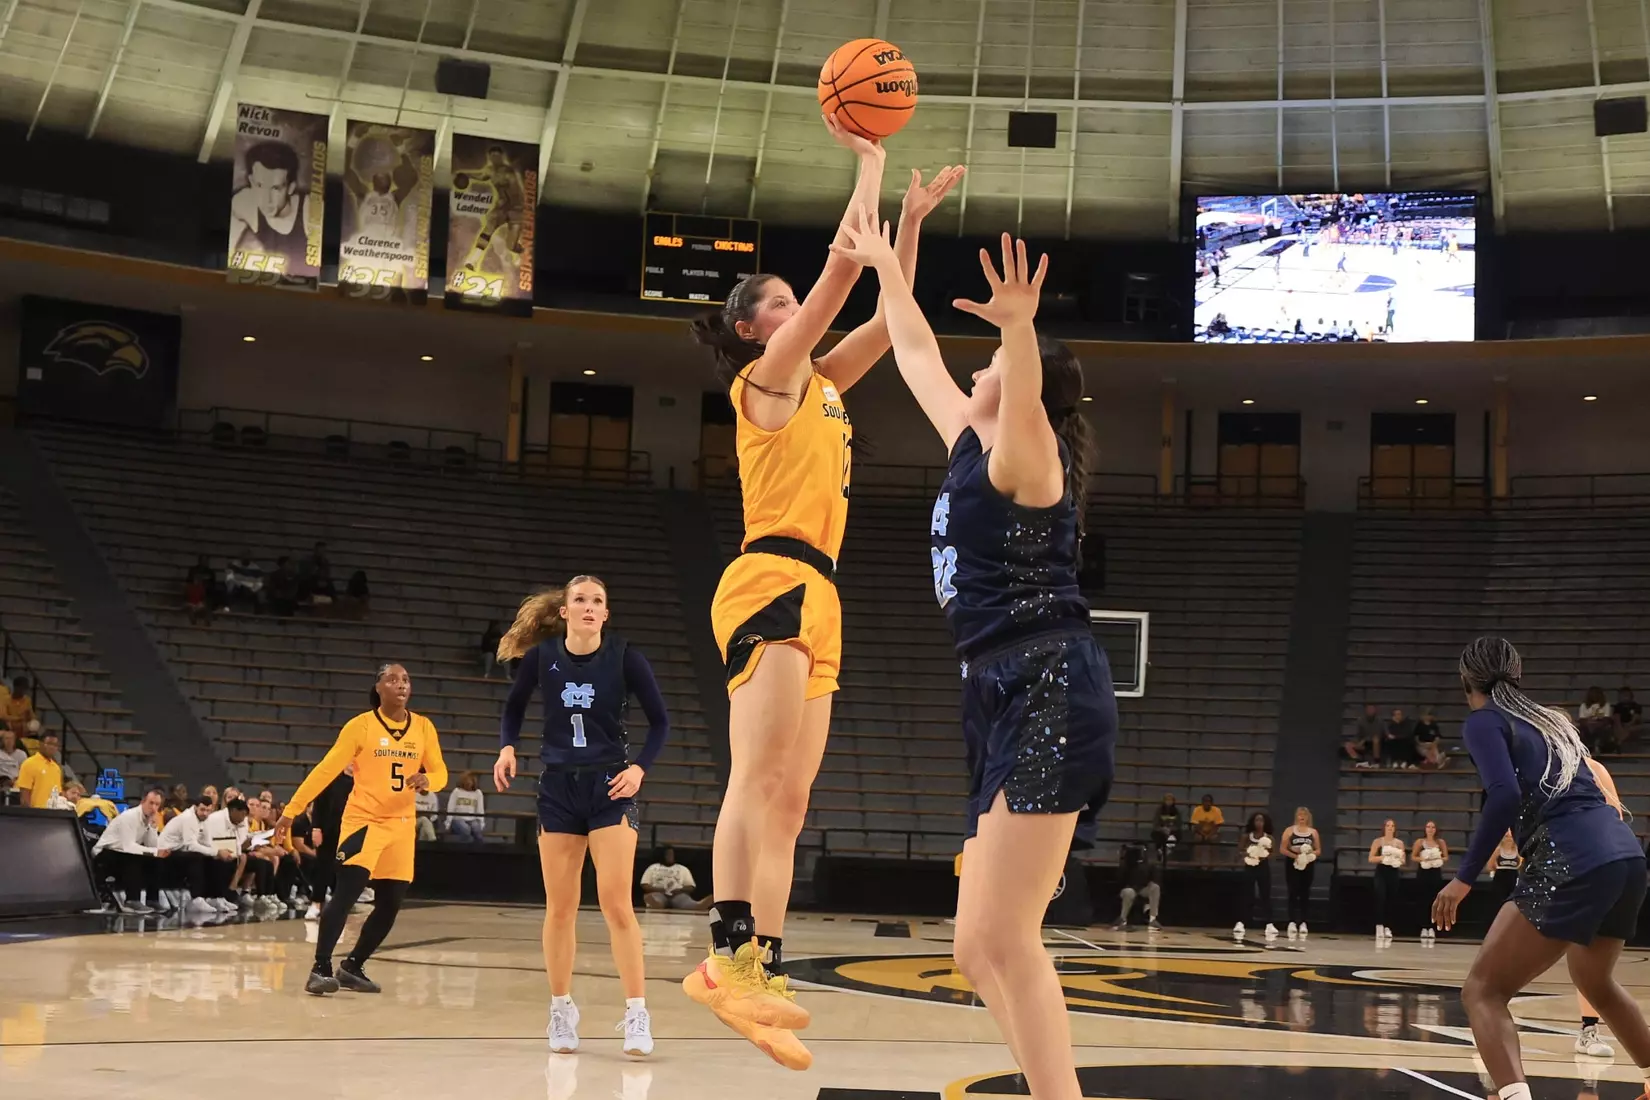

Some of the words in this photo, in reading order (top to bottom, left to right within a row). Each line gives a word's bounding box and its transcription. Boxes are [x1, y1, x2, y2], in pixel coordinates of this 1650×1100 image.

[239, 106, 270, 121] Nick
[238, 121, 281, 138] Revon
[453, 190, 494, 205] Wendell
[456, 203, 490, 215] Ladner
[358, 236, 401, 250] Clarence
[343, 245, 415, 263] Weatherspoon
[231, 251, 285, 285] #55
[519, 254, 535, 292] MISS
[342, 264, 396, 300] #35
[452, 271, 504, 304] #21
[571, 713, 587, 747] 1
[373, 748, 406, 758] SOUTHERN
[391, 762, 404, 792] 5
